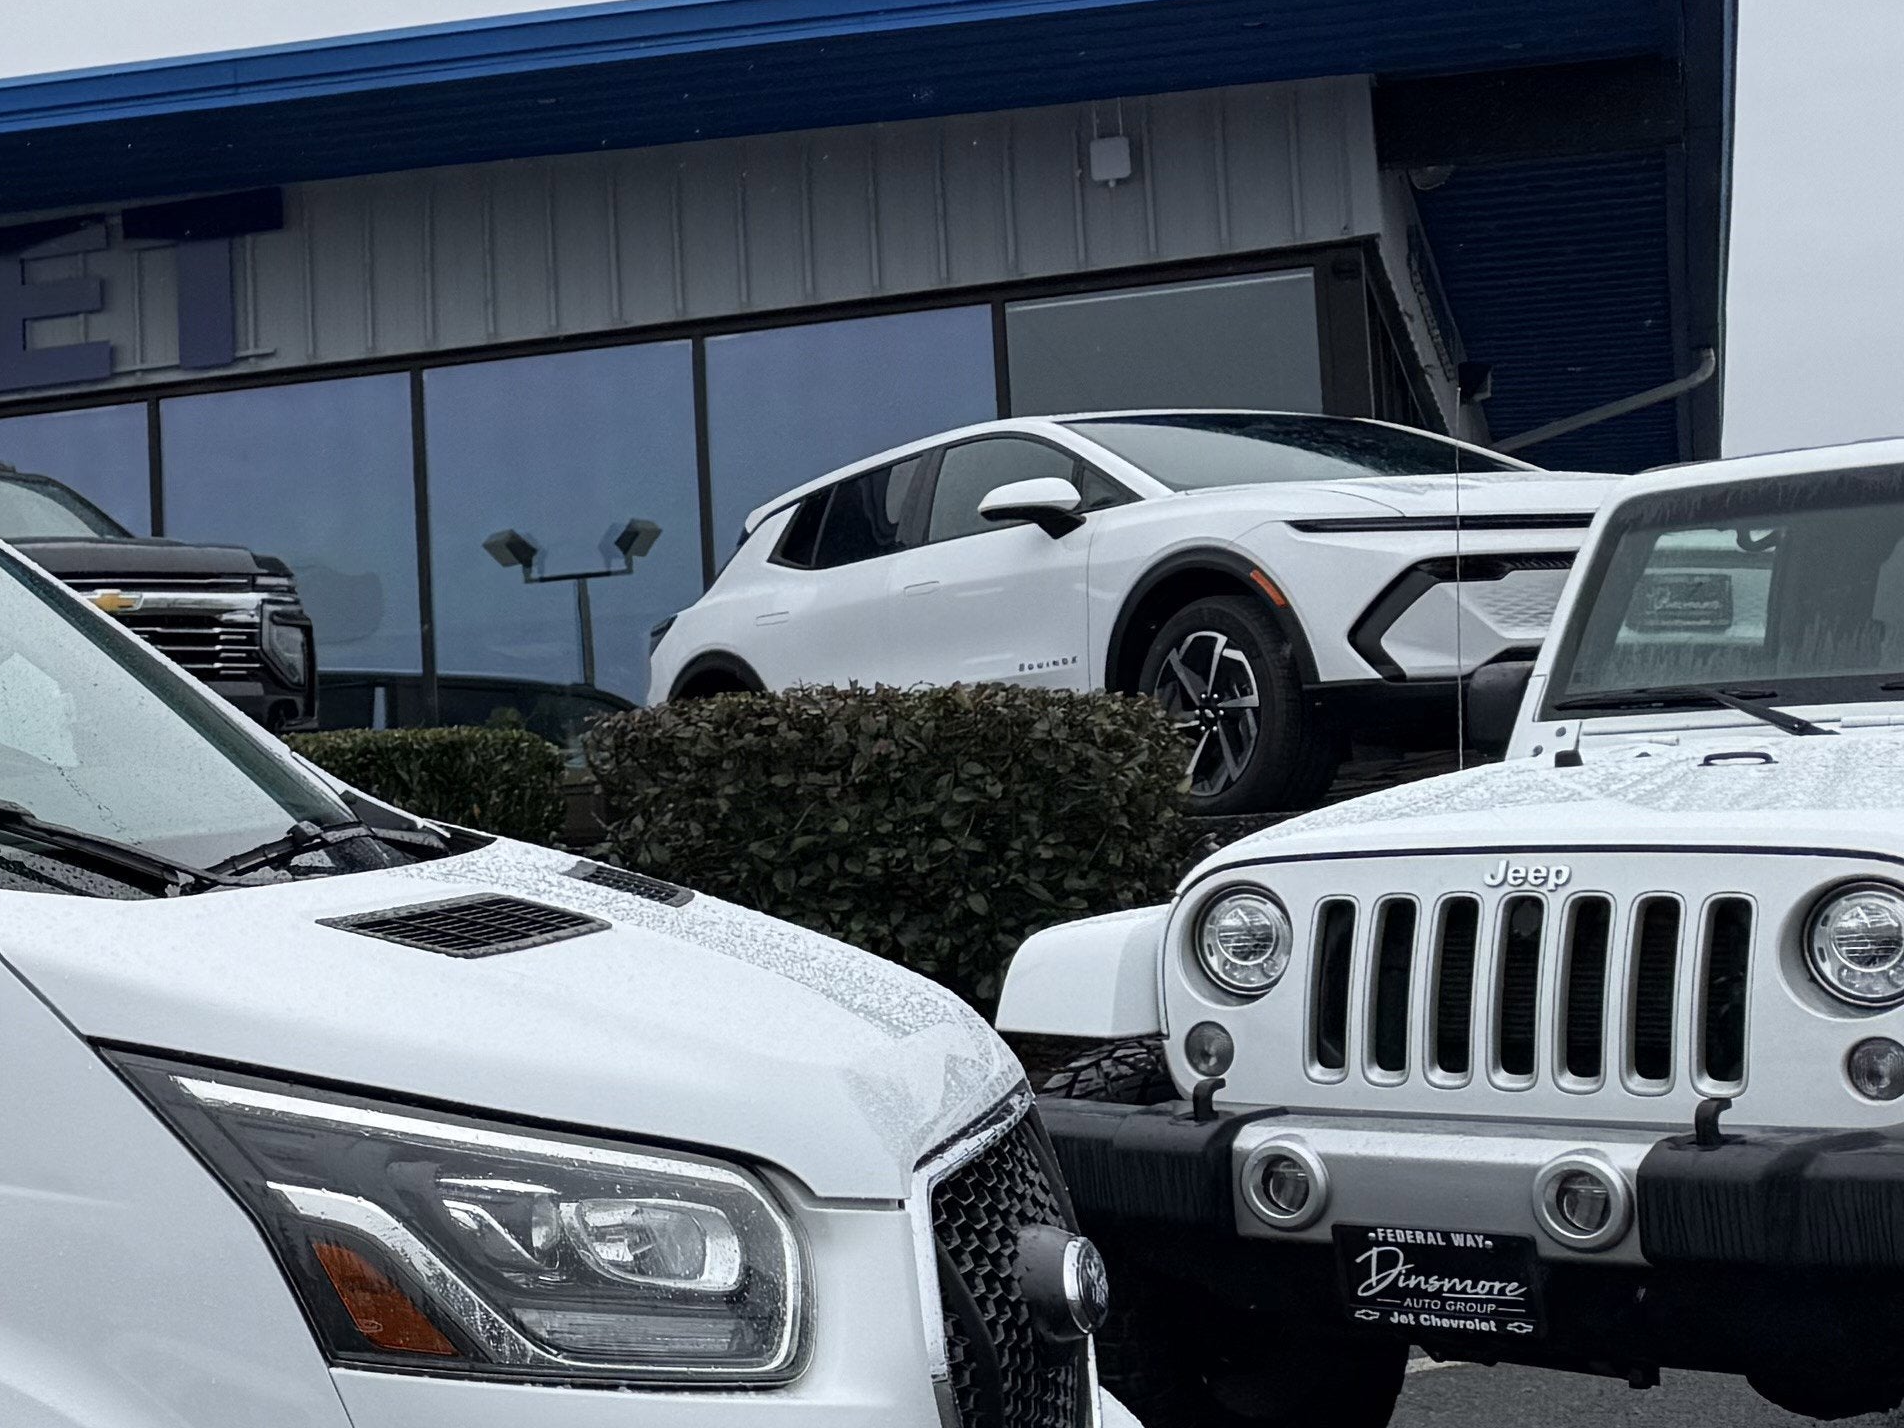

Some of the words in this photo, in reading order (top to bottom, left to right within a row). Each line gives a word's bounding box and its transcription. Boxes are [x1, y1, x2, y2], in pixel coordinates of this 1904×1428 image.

[1483, 859, 1571, 892] Jeep
[1377, 1228, 1446, 1246] FEDERAL
[1450, 1232, 1484, 1248] WAY
[1355, 1246, 1527, 1296] Dinsmore
[1403, 1298, 1441, 1310] AUTO
[1445, 1300, 1497, 1314] GROUP
[1389, 1311, 1416, 1325] Jet
[1419, 1314, 1497, 1332] Chevrolet
